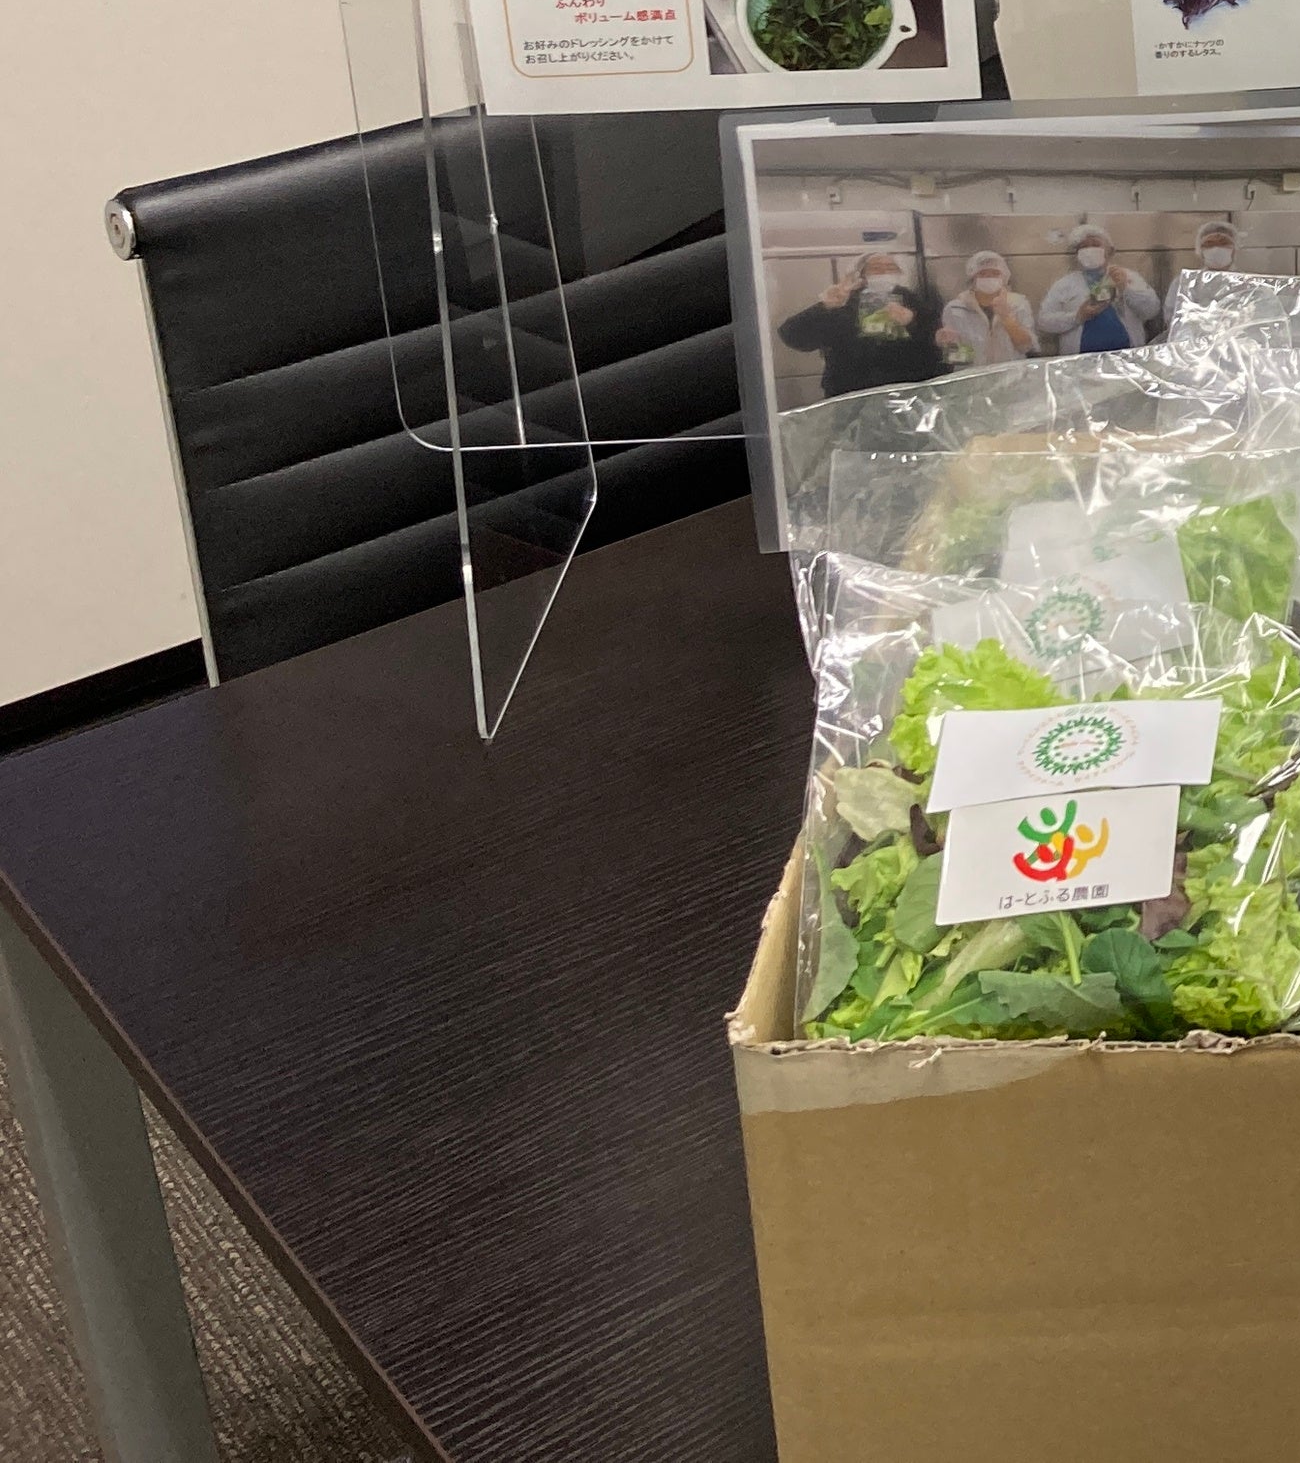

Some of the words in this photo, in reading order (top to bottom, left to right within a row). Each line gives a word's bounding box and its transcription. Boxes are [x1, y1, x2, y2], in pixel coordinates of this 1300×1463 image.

[999, 884, 1110, 911] はーとふる農園
